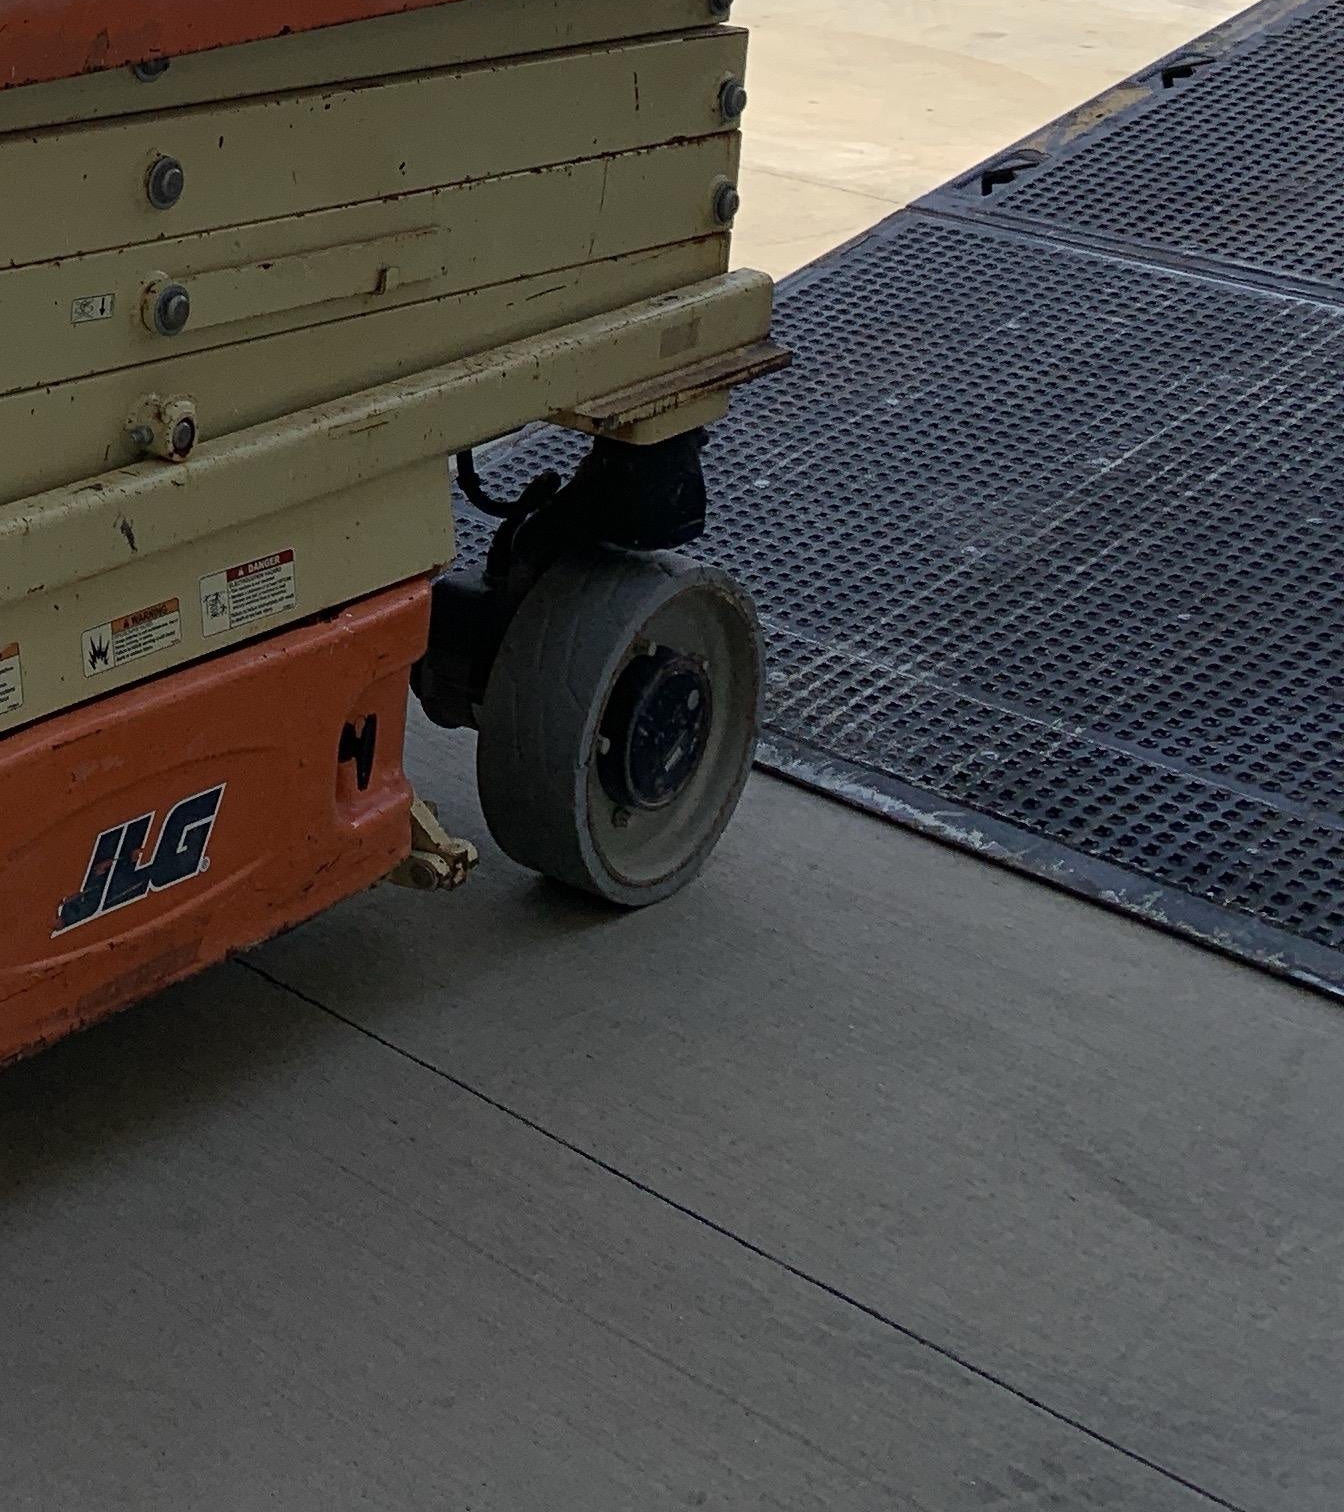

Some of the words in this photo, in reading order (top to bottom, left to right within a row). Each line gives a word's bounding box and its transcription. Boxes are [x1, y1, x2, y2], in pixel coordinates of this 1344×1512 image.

[248, 555, 281, 574] DANGER
[132, 604, 168, 625] WARNING
[50, 782, 227, 940] JLG
